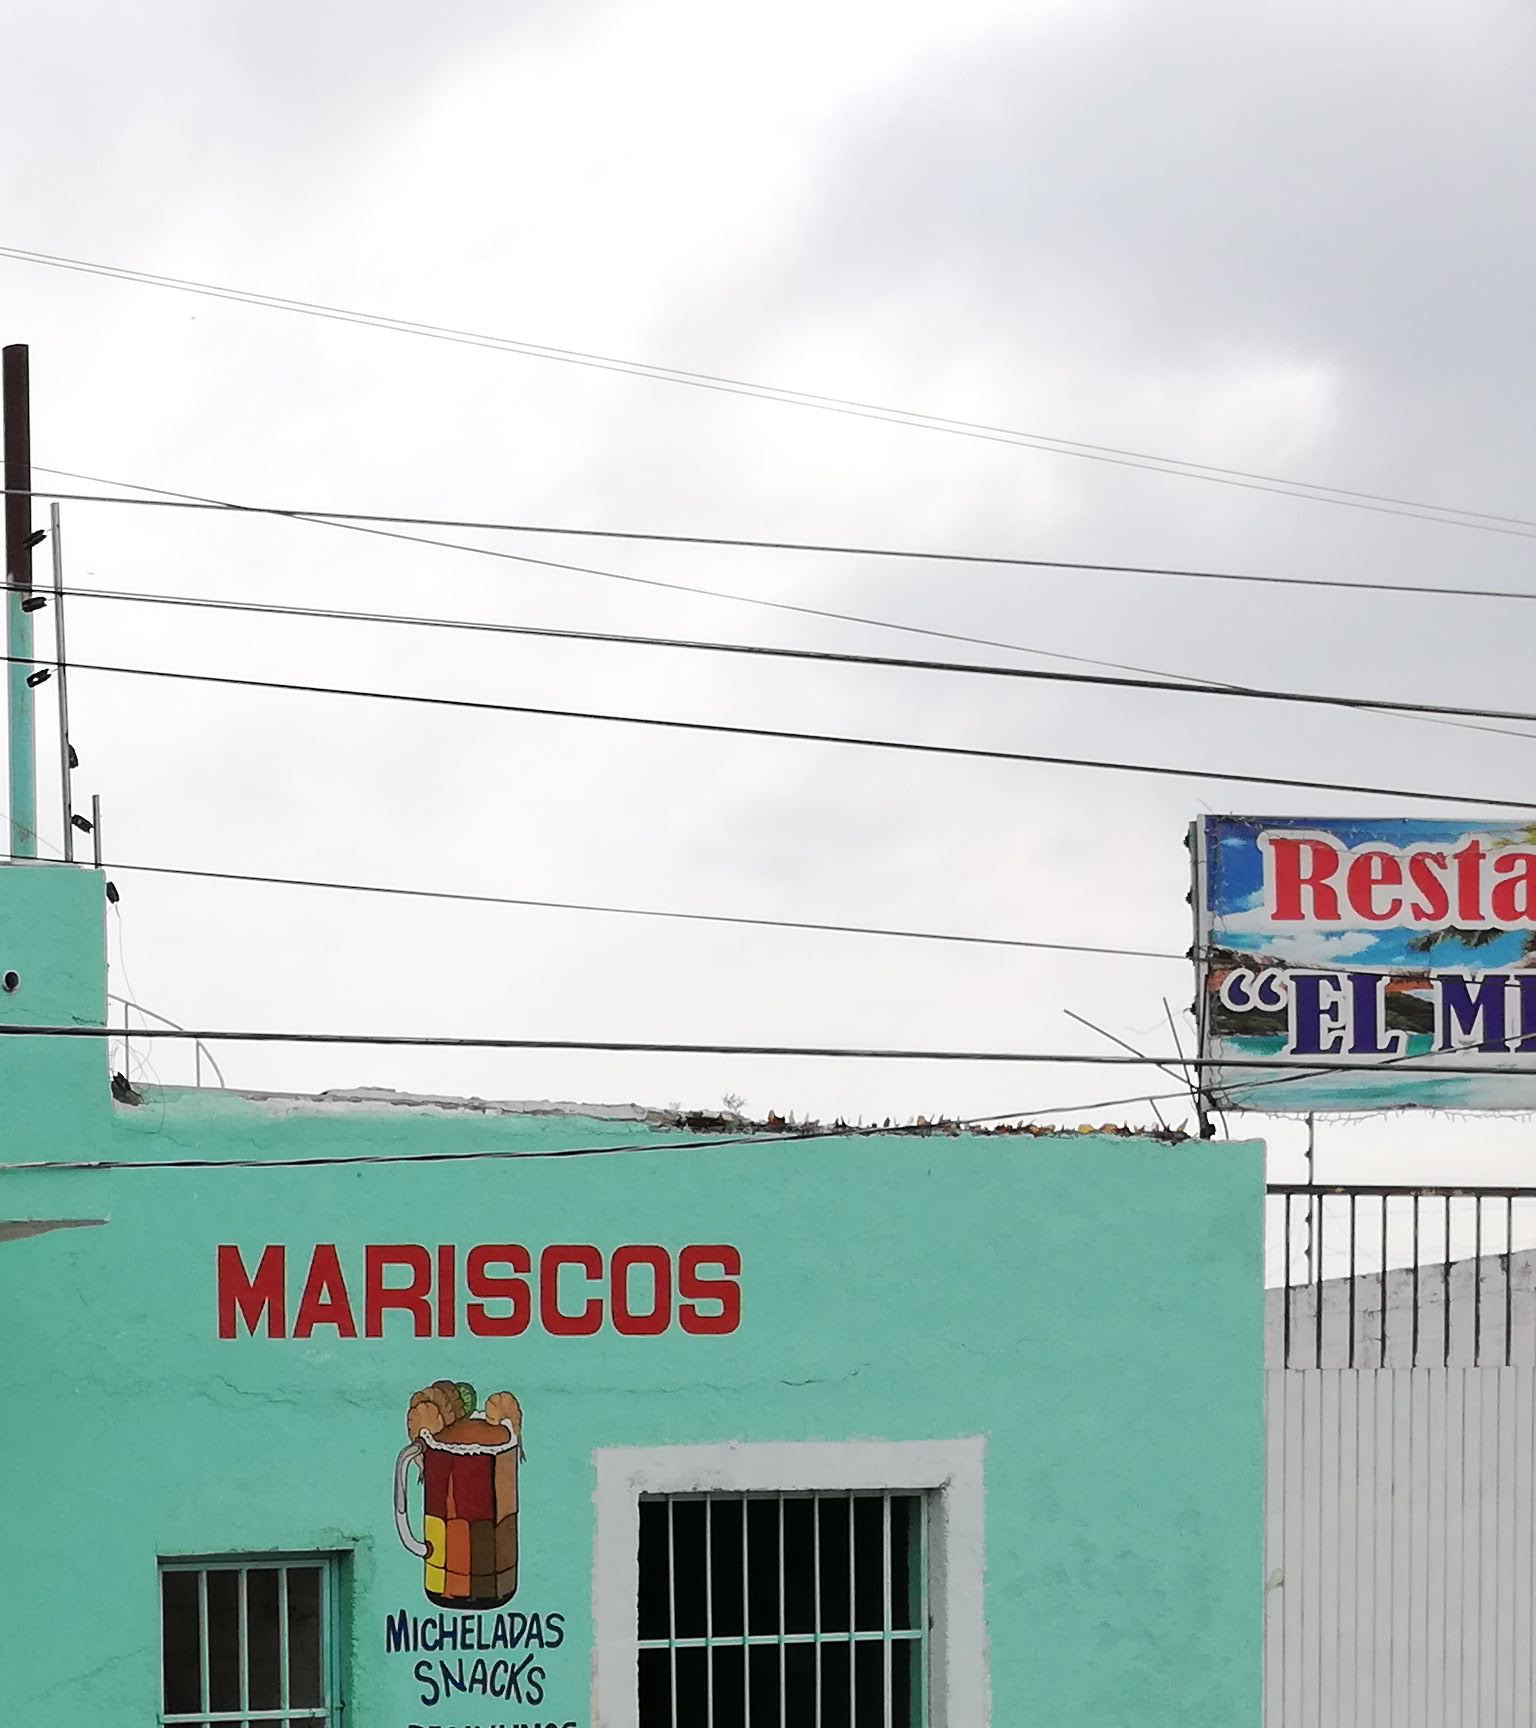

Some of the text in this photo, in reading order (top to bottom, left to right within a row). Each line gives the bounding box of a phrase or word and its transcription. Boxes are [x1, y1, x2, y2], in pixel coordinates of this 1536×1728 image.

[217, 1244, 742, 1339] MARISCOS
[386, 1609, 565, 1653] MICHELADAS
[414, 1653, 546, 1705] SNACKS
